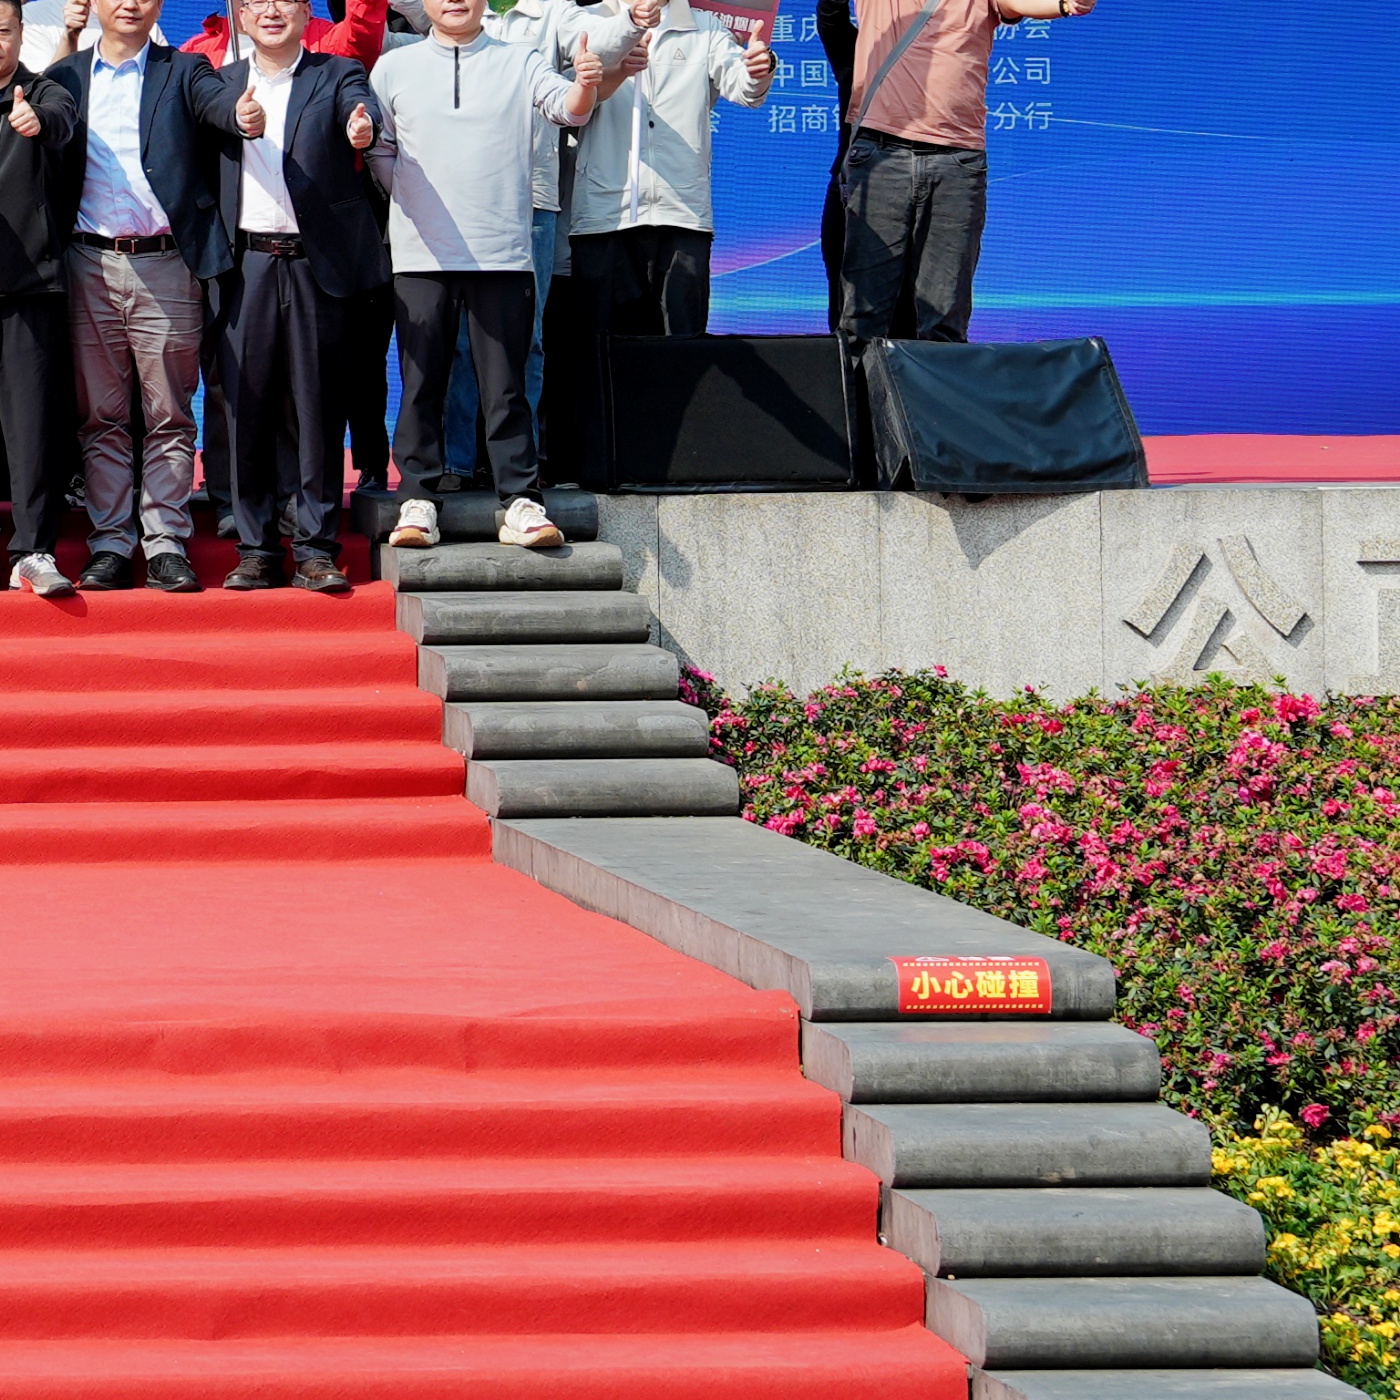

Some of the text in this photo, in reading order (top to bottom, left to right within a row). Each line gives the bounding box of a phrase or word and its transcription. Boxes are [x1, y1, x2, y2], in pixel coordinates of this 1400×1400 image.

[992, 56, 1051, 86] 公司
[992, 102, 1053, 131] 分行
[911, 970, 1040, 1000] 小心碰撞
